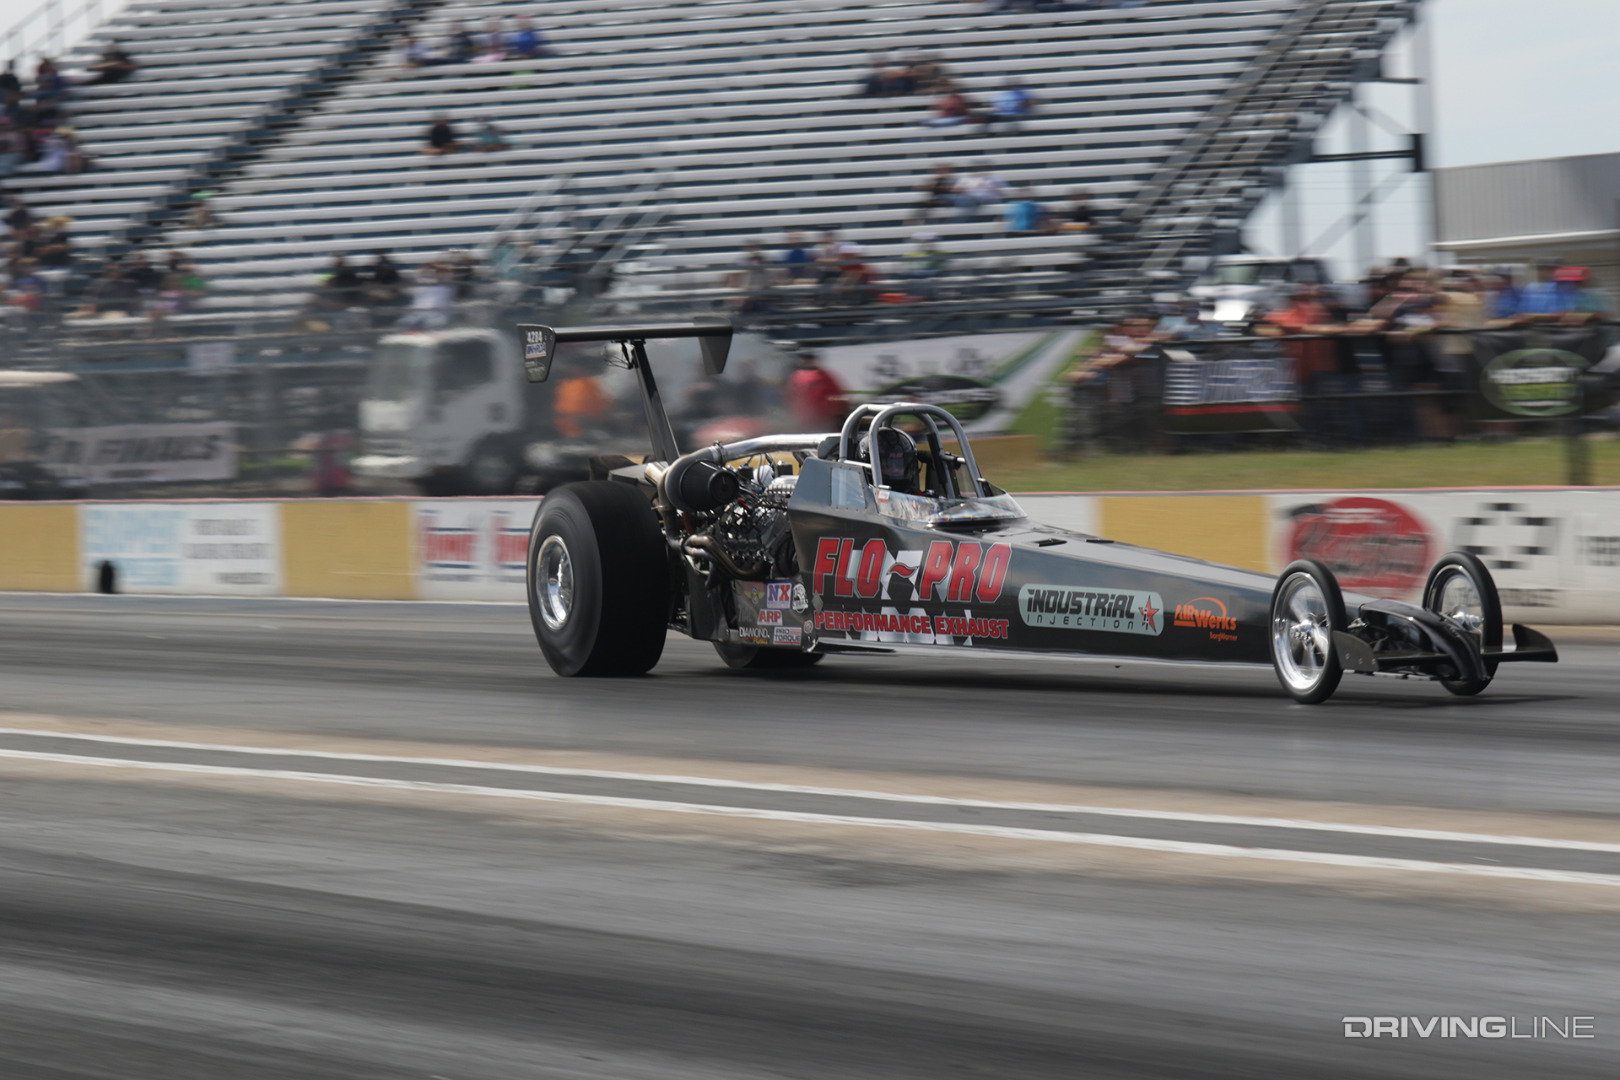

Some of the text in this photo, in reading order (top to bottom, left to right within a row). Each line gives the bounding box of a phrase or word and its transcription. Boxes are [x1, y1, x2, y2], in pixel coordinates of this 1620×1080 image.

[768, 584, 791, 601] NX
[758, 610, 782, 623] ARP
[814, 610, 1009, 639] PERFORMANCE EXHAUST
